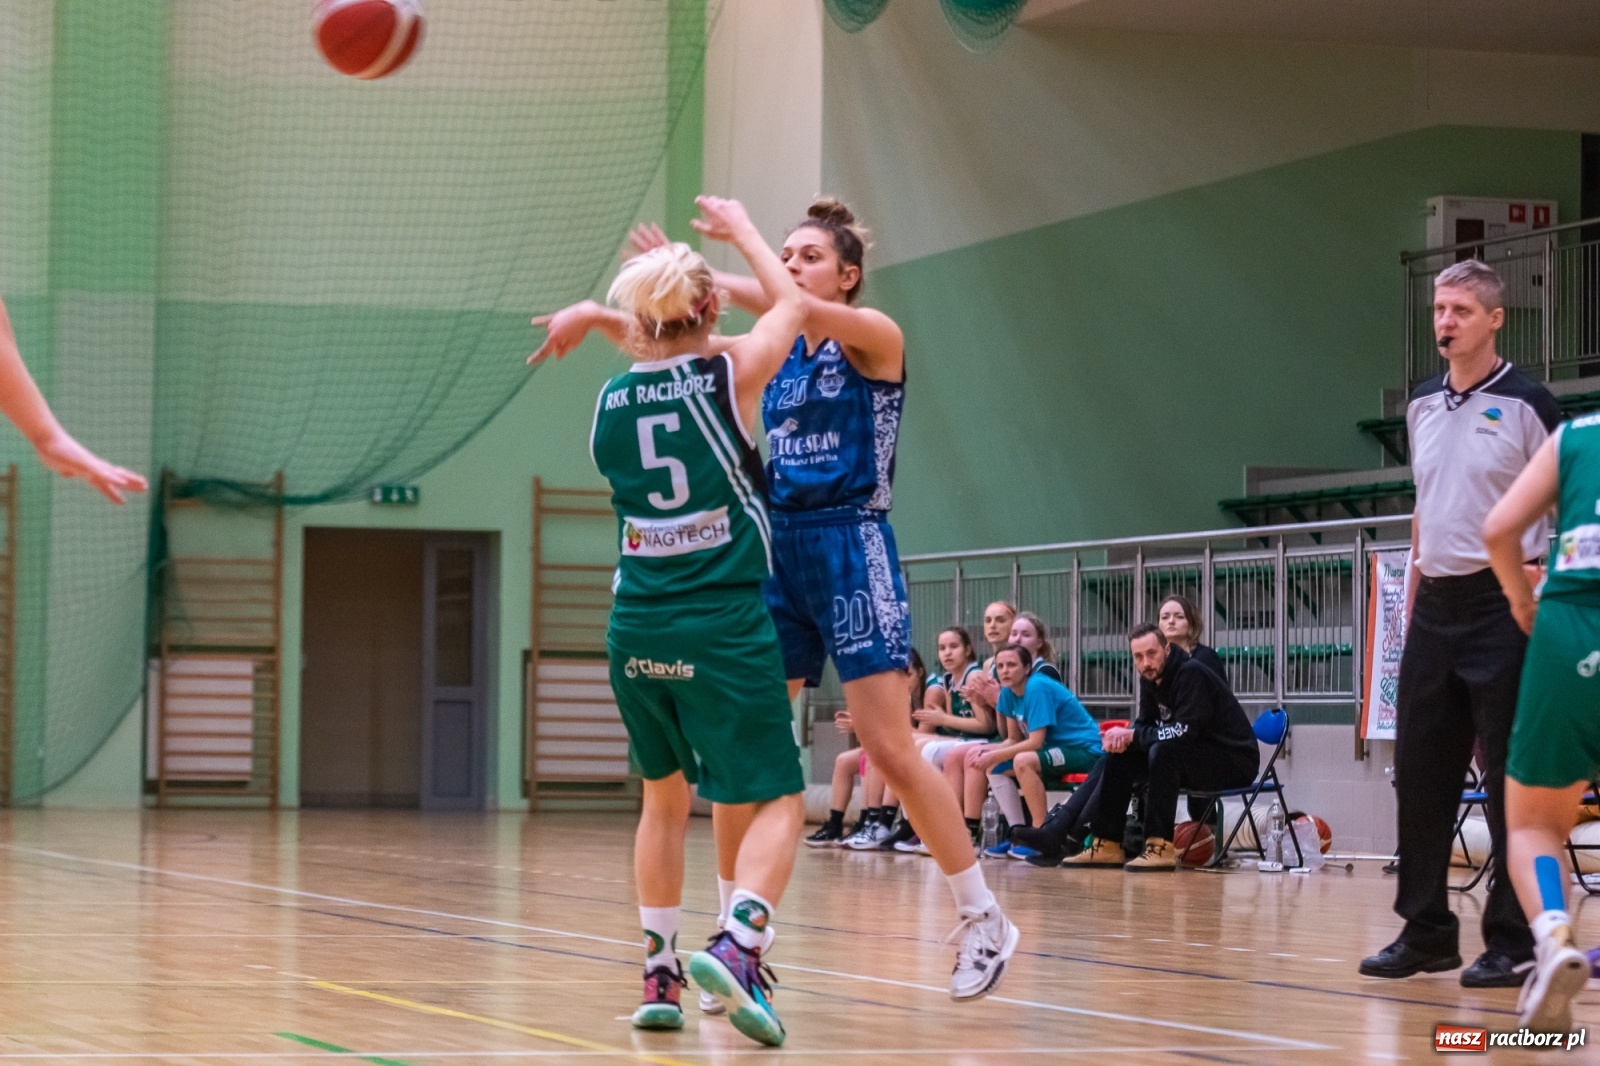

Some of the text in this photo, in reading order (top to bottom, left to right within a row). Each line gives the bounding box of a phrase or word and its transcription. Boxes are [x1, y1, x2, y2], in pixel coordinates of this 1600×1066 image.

[605, 387, 629, 411] RKK
[777, 375, 809, 410] 20
[636, 412, 690, 510] 5
[833, 590, 873, 646] 20
